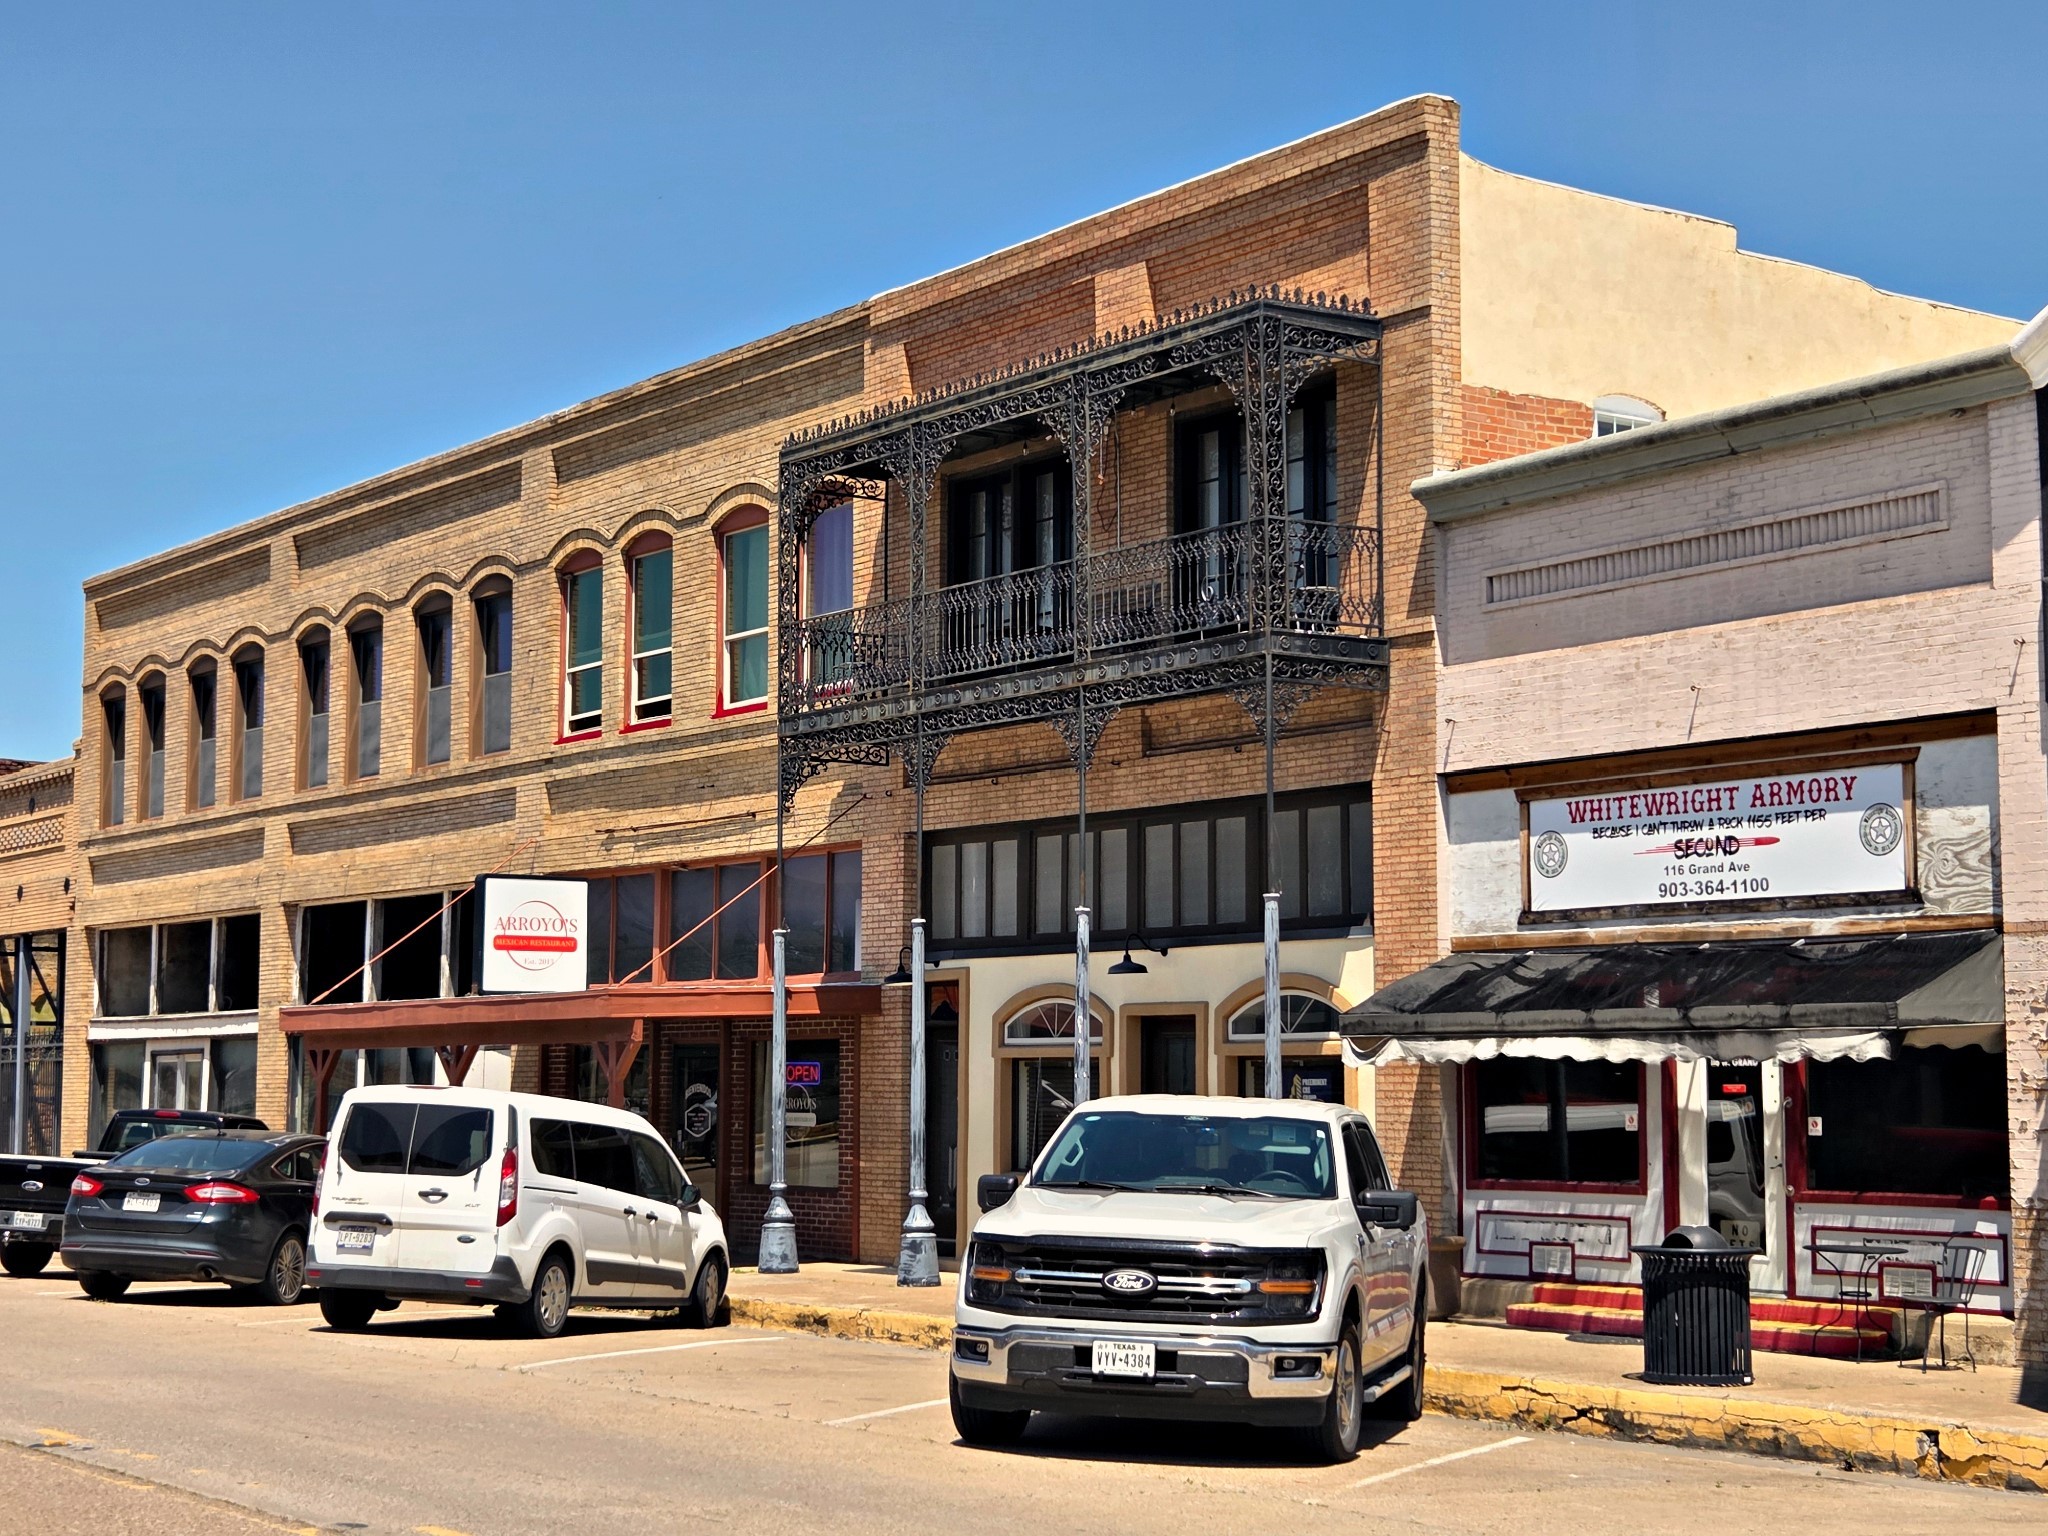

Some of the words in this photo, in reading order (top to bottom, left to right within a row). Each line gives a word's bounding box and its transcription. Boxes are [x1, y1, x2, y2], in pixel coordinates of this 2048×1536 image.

[1566, 785, 1740, 824] WHITEWRIGHT
[1750, 776, 1858, 809] ARMORY
[1592, 824, 1633, 839] BECAUSE
[1635, 824, 1639, 837] I
[1641, 820, 1669, 836] CAN'T
[1672, 818, 1704, 833] THROW
[1707, 817, 1715, 831] A
[1717, 816, 1744, 830] ROCK
[1775, 810, 1803, 825] FEET
[1804, 808, 1828, 823] PER
[1674, 835, 1741, 860] SECOND
[1663, 864, 1685, 877] 116
[1688, 861, 1725, 875] Grand
[1728, 861, 1751, 874] Ave
[1658, 877, 1770, 899] 903-364-1100
[494, 915, 578, 933] ARROYO'S
[496, 938, 528, 947] MEXICAN
[530, 939, 575, 948] RESTAURANT
[786, 1065, 819, 1081] OPEN
[1731, 1223, 1749, 1237] NO
[1113, 1274, 1144, 1289] Ford
[1112, 1343, 1137, 1351] TEXAS
